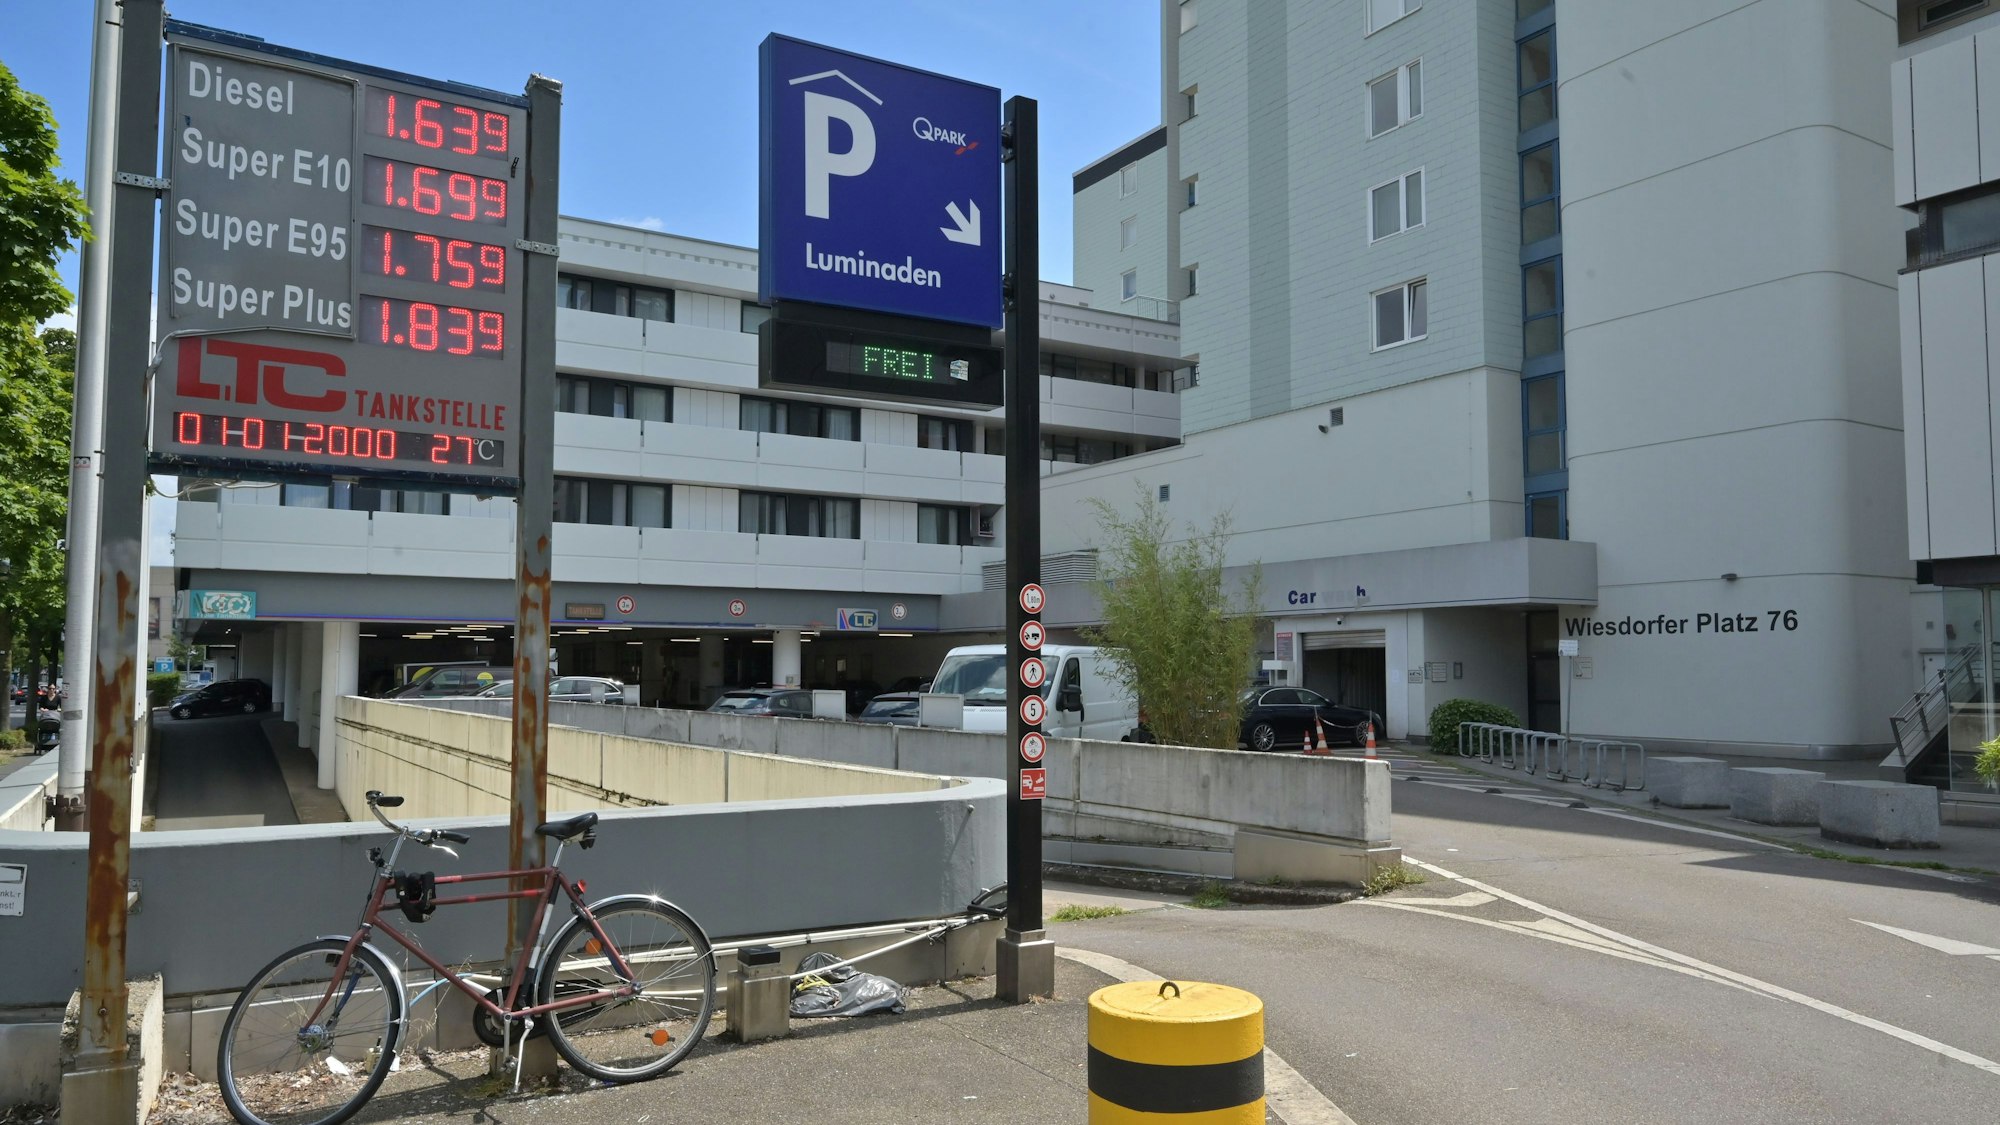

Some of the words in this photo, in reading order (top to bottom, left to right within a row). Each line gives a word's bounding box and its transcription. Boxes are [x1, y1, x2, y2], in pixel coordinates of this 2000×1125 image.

[189, 60, 294, 115] Diesel
[387, 94, 508, 155] 1.639
[181, 127, 285, 180] Super
[293, 148, 351, 193] E10
[804, 91, 876, 219] P
[385, 162, 507, 222] 1.699
[175, 198, 280, 251] Super
[287, 217, 347, 261] E95
[383, 231, 505, 289] 1.759
[805, 242, 941, 288] Luminaden
[173, 267, 275, 320] Super
[283, 284, 352, 329] Plus
[382, 300, 504, 356] 1.839
[176, 335, 347, 413] LTC
[864, 346, 933, 380] FREI
[354, 389, 506, 431] TANKSTELLE
[853, 612, 875, 627] LTC
[1288, 590, 1317, 605] Car
[1565, 614, 1688, 637] Wiesdorfer
[1696, 612, 1758, 633] Platz
[1766, 609, 1799, 632] 76
[1030, 703, 1036, 716] 5
